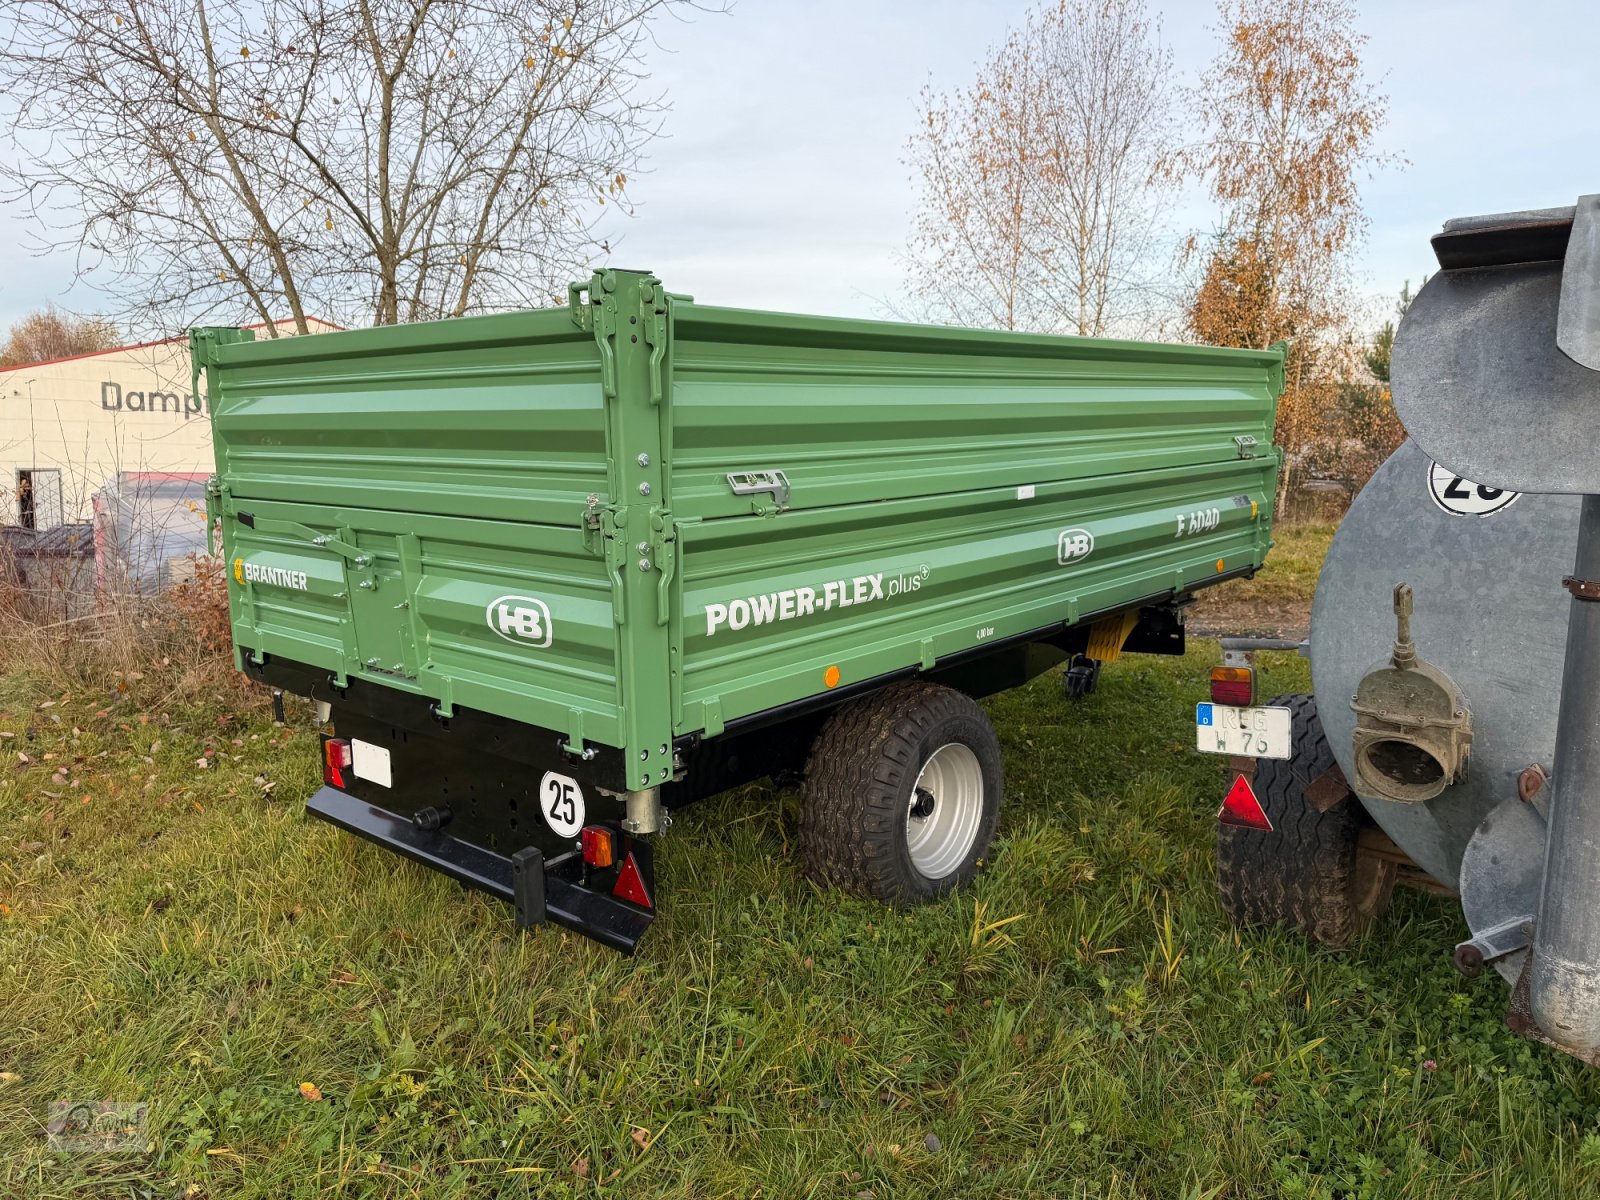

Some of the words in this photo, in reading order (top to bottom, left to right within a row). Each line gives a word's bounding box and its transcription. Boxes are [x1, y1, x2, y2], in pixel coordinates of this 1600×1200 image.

[1187, 507, 1220, 535] 6040
[1063, 534, 1089, 559] HB
[244, 562, 307, 591] BRANTNER
[704, 572, 885, 637] POWER-FLEX
[498, 603, 543, 639] HB
[1202, 717, 1209, 725] D
[1221, 707, 1268, 732] REG
[1241, 731, 1268, 754] 76
[548, 779, 576, 826] 25
